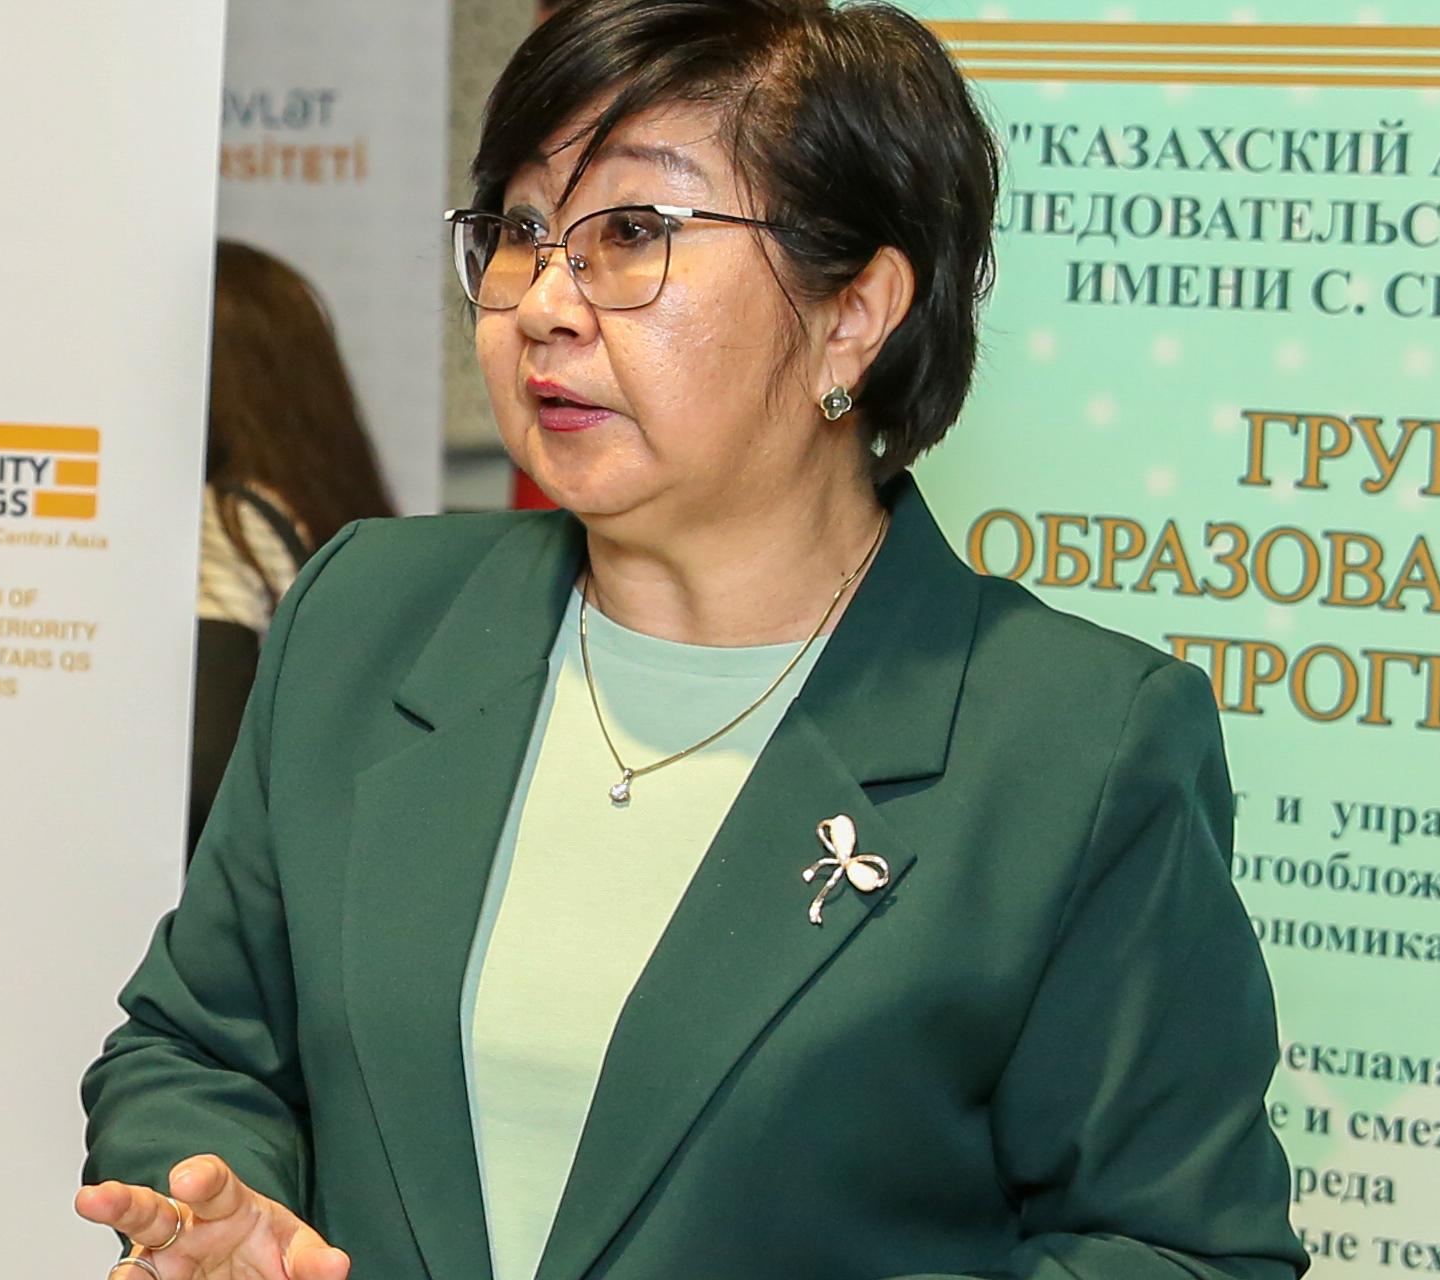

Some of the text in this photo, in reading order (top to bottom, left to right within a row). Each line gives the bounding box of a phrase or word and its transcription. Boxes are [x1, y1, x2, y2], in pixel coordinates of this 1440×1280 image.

[1008, 120, 1410, 181] "КАЗАХСКИЙ
[1065, 261, 1293, 313] ИМЕНИ
[1312, 269, 1364, 317] С.
[66, 533, 109, 549] Asia
[10, 588, 39, 608] OF
[59, 651, 92, 674] QS
